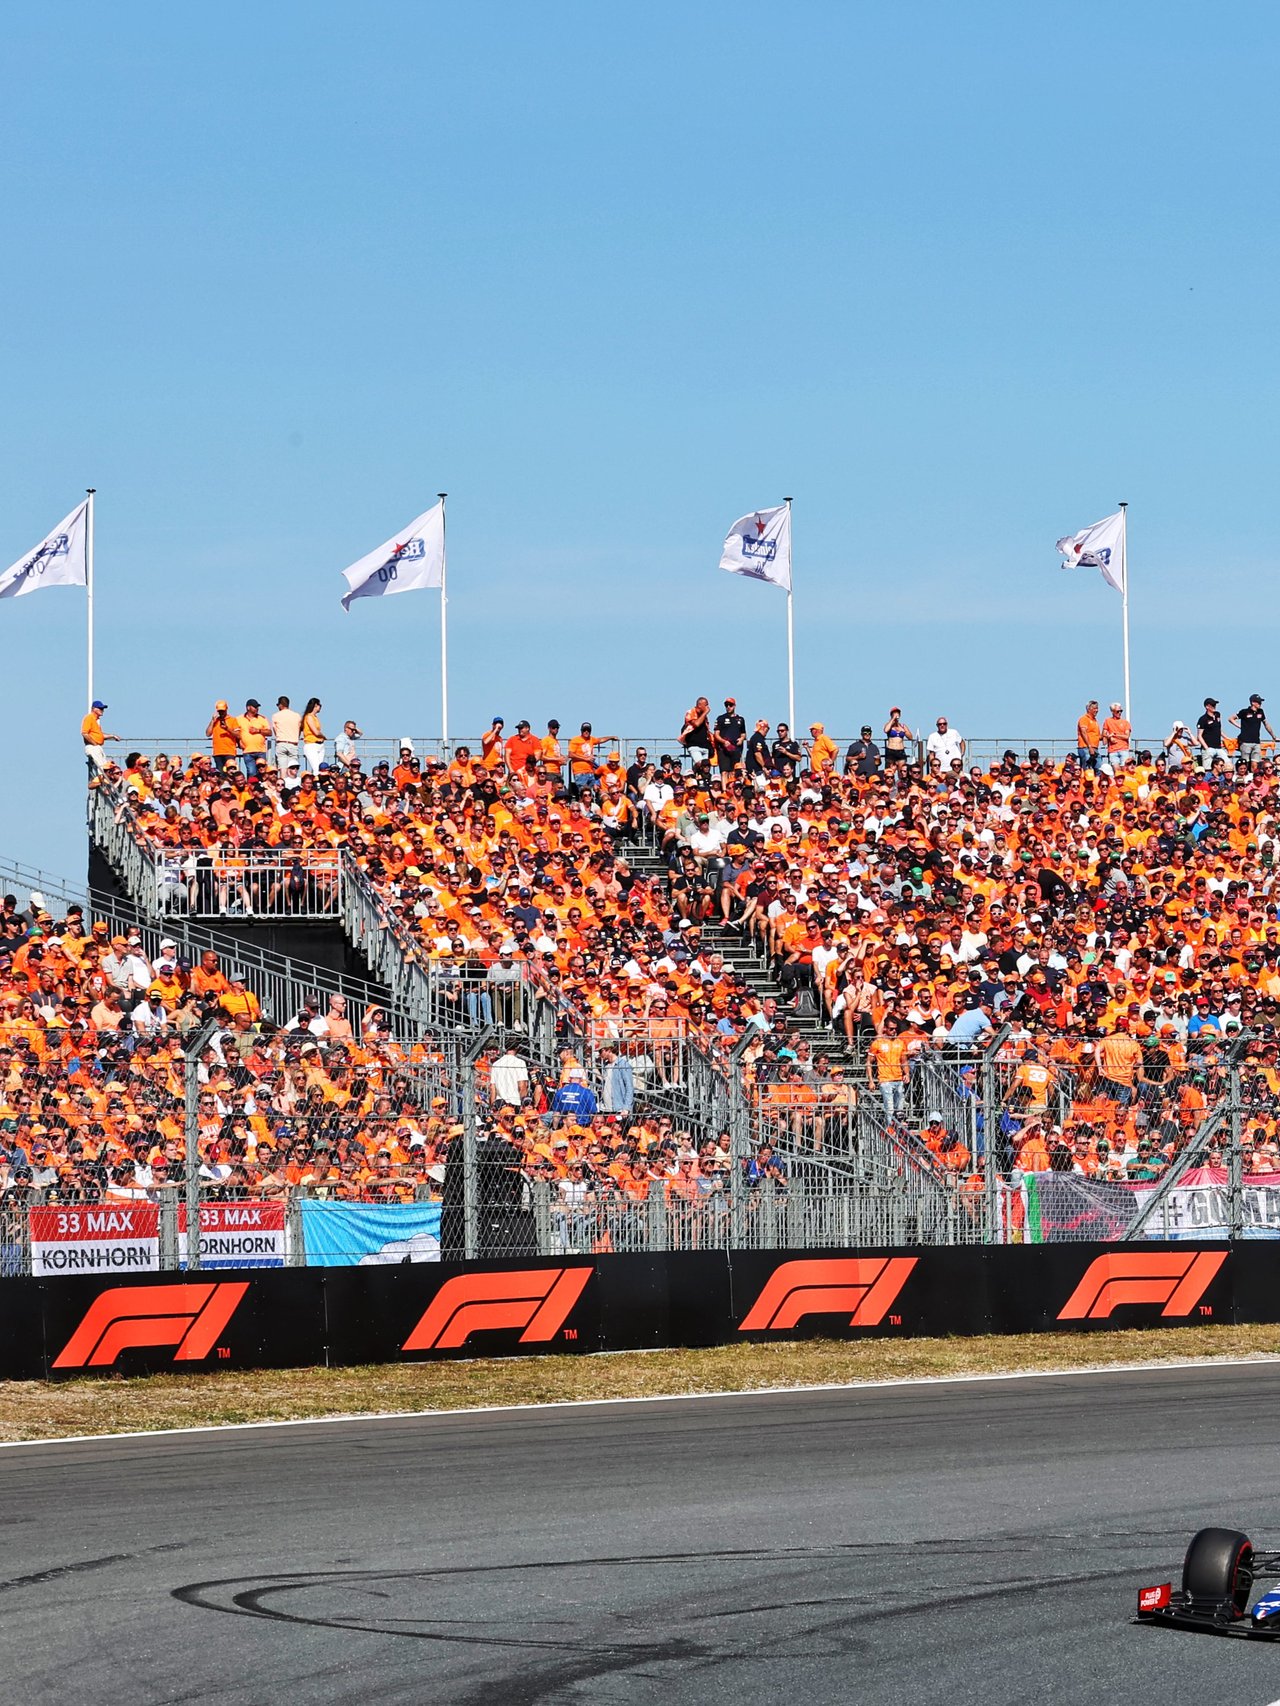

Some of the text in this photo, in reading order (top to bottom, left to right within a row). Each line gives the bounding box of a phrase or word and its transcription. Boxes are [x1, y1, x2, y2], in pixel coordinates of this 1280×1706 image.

[57, 1210, 134, 1234] 33 MAX
[200, 1208, 262, 1226] 33 MAX
[42, 1246, 151, 1270] KORNHORN
[199, 1236, 276, 1255] ORNHORN
[737, 1257, 919, 1331] F1
[1057, 1251, 1229, 1320] F1
[52, 1282, 250, 1368] F1
[402, 1267, 594, 1351] F1
